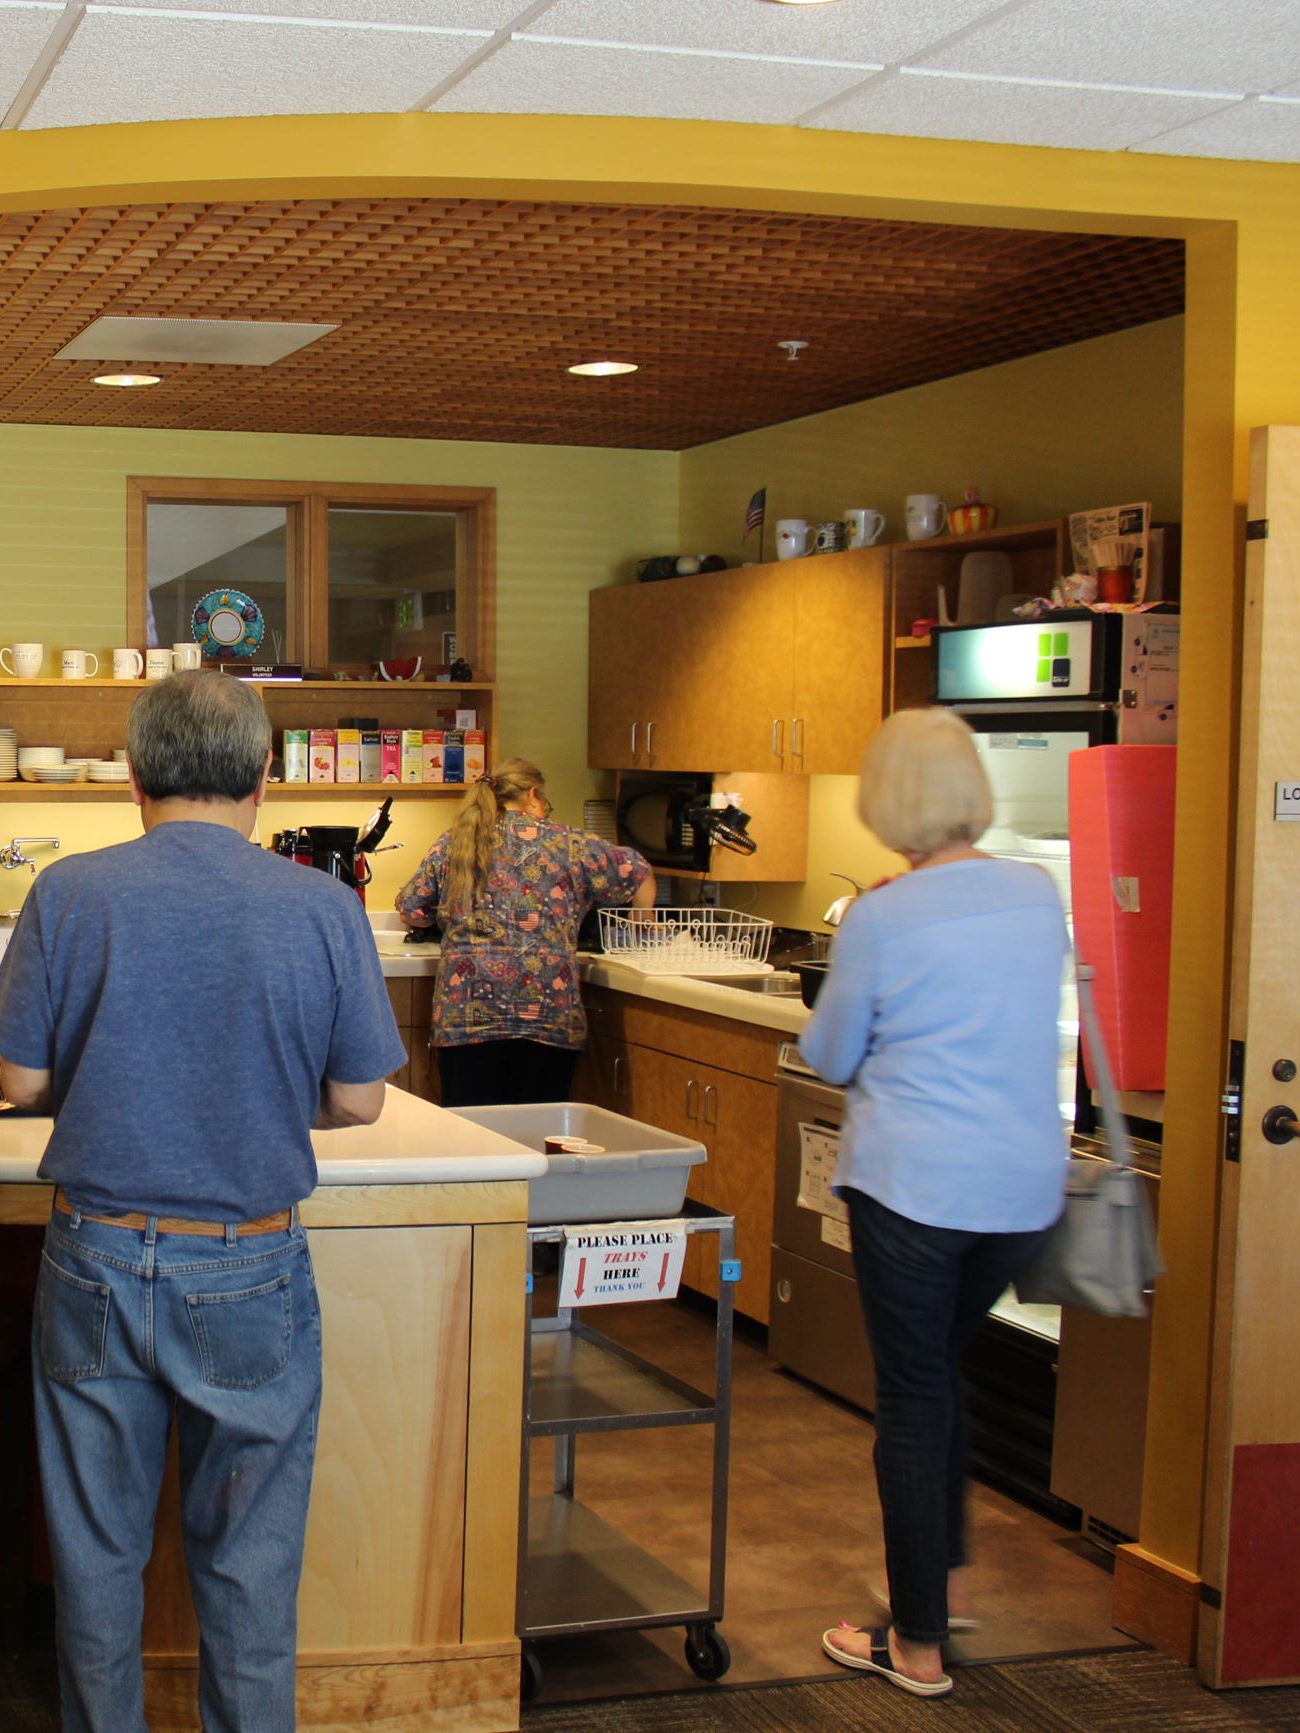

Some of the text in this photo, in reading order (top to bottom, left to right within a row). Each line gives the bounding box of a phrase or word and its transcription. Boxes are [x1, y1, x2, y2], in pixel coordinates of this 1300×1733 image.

[577, 1232, 673, 1248] PLEASE PLACE
[603, 1250, 648, 1264] TRAYS
[603, 1267, 640, 1281] HERE
[594, 1282, 646, 1294] THANK YOU
